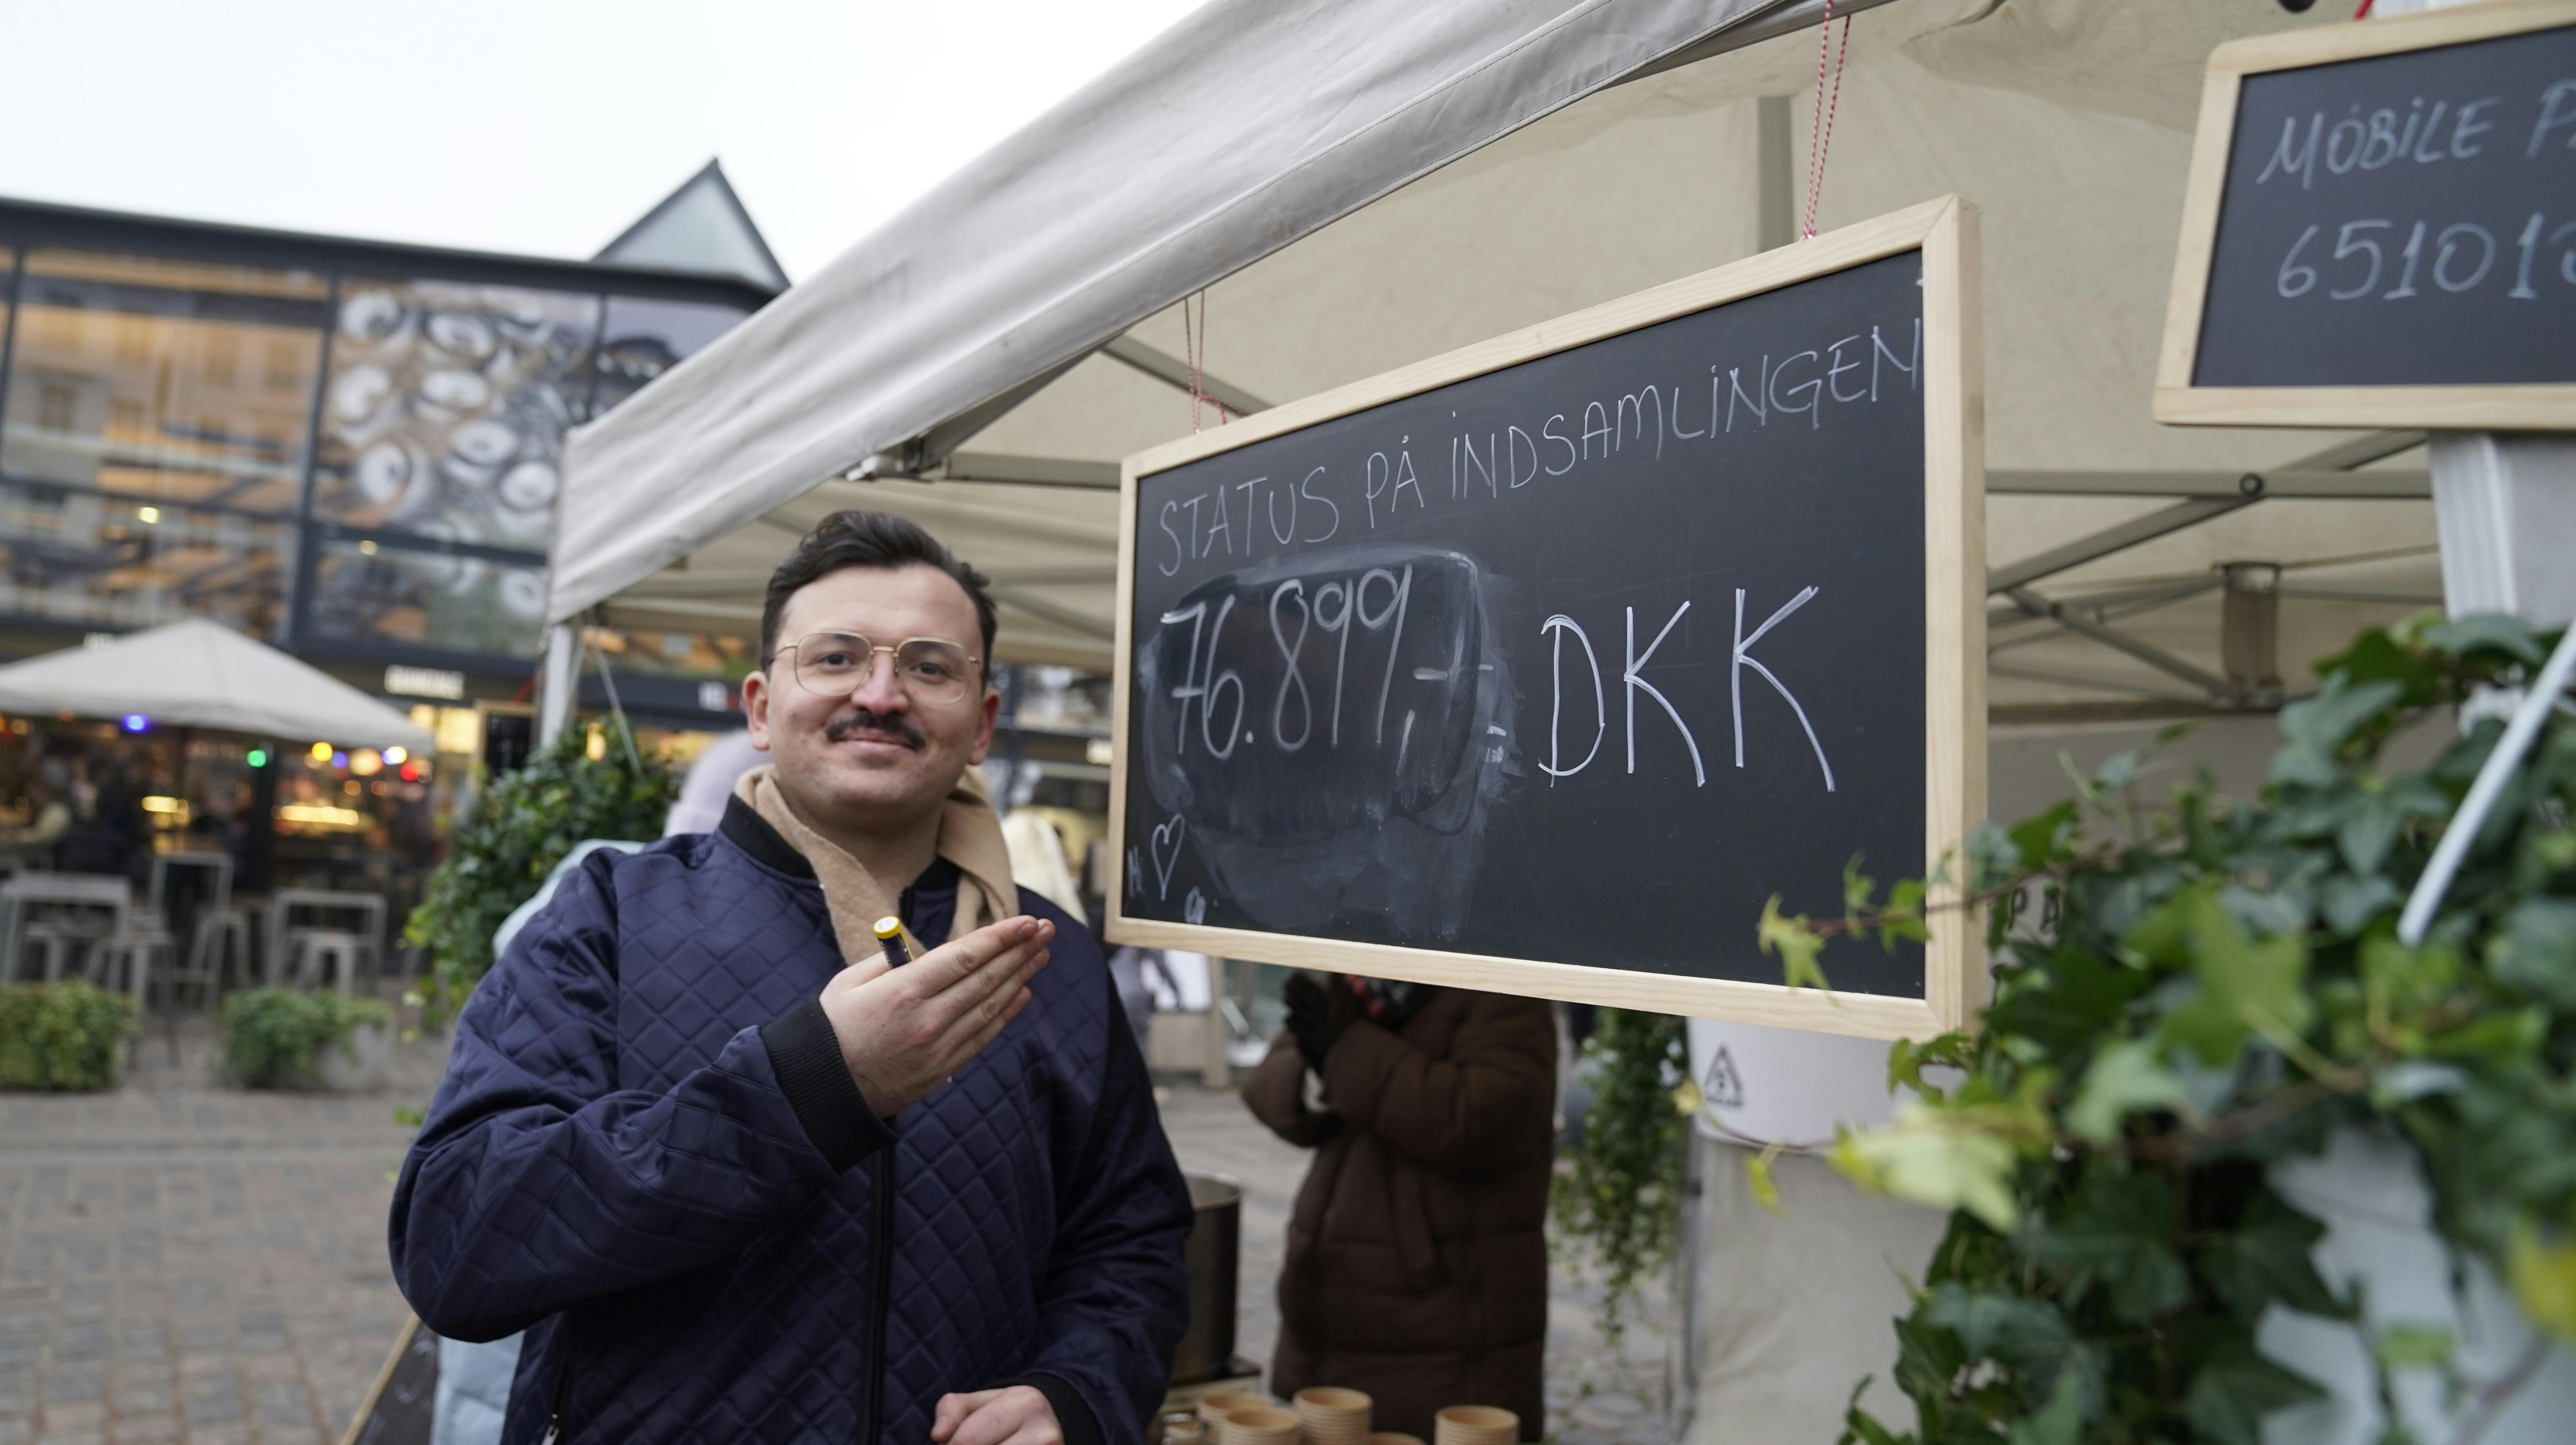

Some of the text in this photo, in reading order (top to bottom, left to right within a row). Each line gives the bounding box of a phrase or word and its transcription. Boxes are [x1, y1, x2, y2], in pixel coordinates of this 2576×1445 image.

[2257, 78, 2576, 189] MOBILE P
[1159, 317, 1921, 576] STATUS PÅ INDSAMLINGEN
[1538, 585, 1836, 792] DKK
